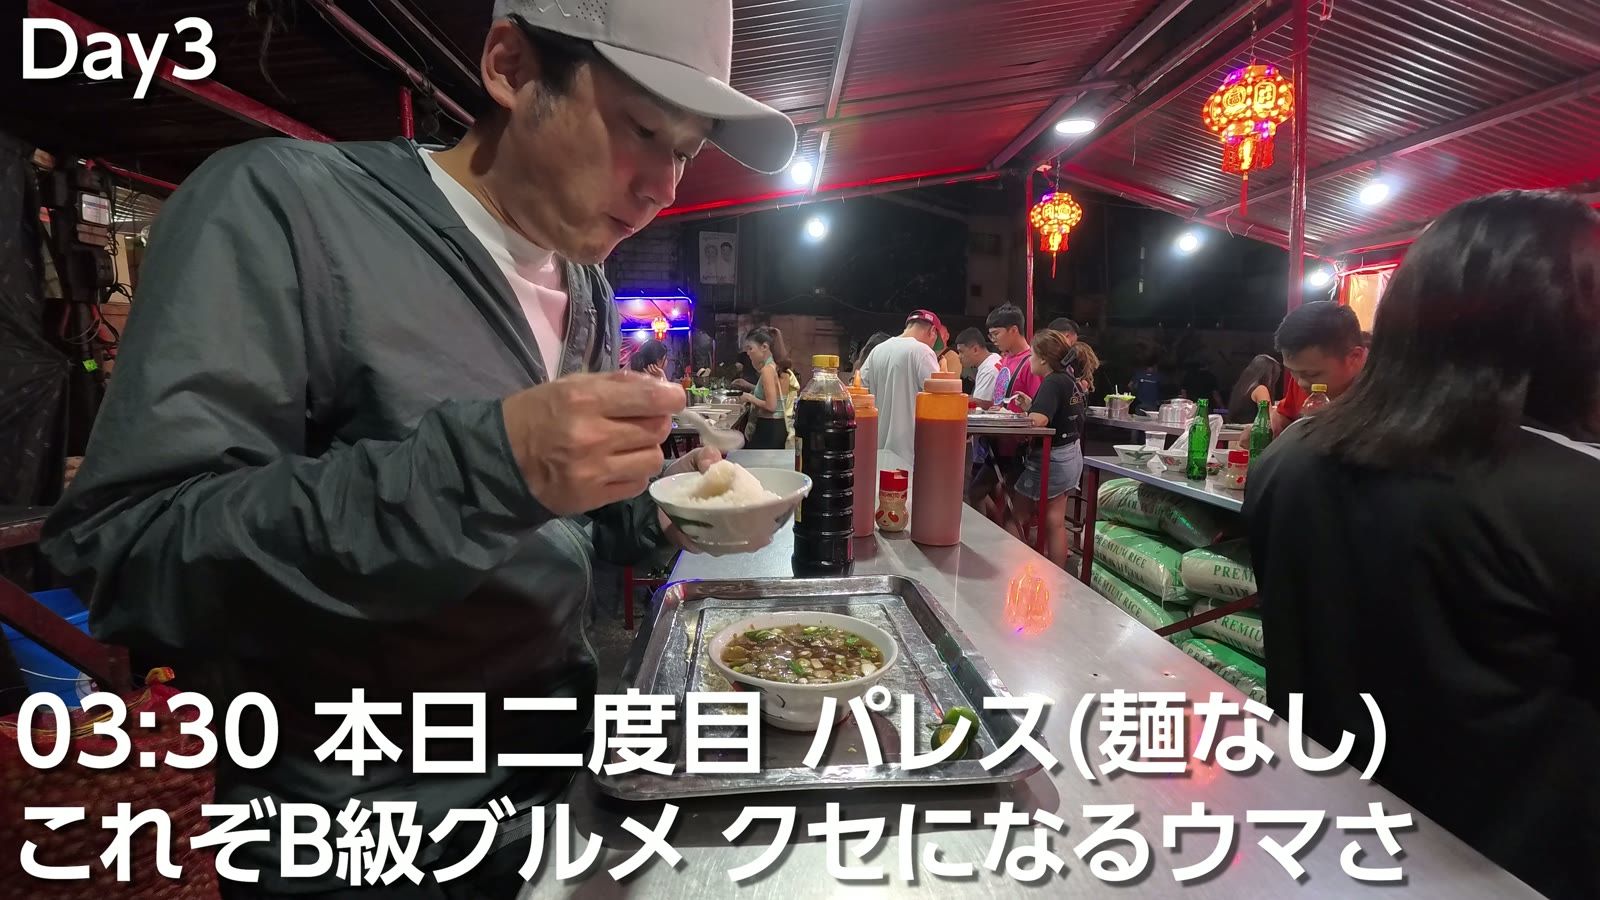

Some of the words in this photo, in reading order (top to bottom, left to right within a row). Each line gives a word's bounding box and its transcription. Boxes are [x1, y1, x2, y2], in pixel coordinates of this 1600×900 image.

[1128, 552, 1148, 569] RICE
[1122, 597, 1143, 618] RICE
[1213, 616, 1262, 642] REMIU
